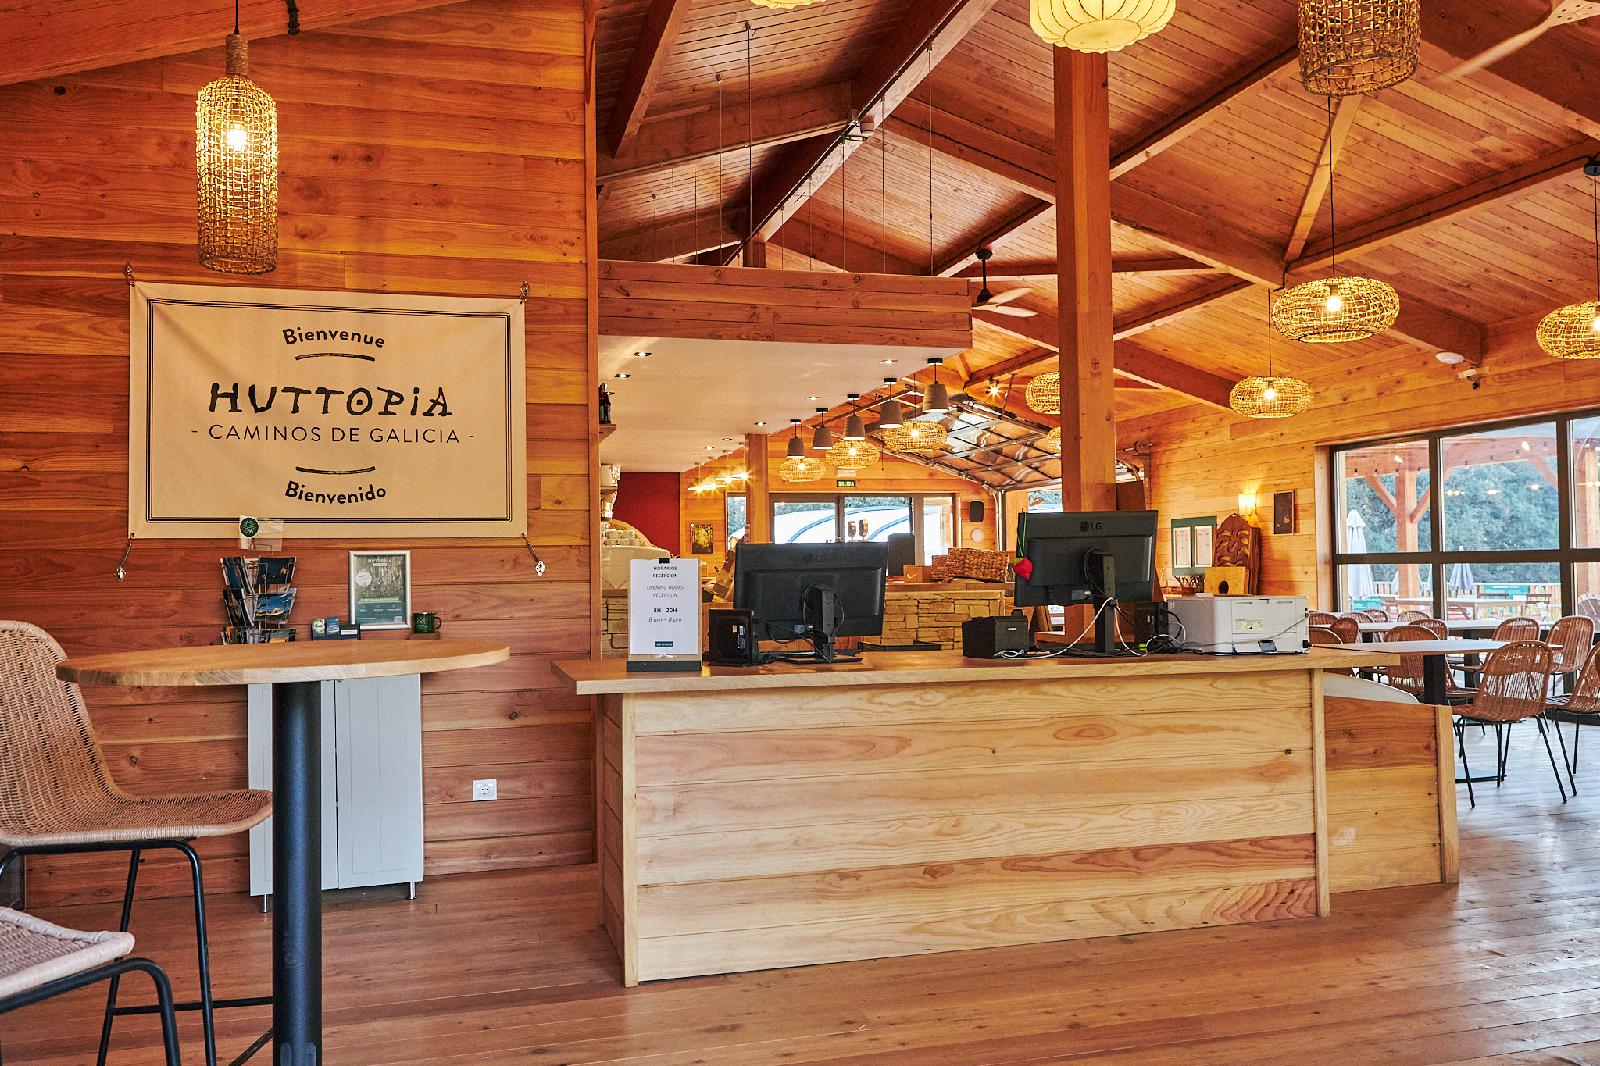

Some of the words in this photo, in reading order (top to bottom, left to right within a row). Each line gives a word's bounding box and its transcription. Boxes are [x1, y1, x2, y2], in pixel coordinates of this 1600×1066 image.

[283, 326, 385, 349] Bienvenue
[208, 424, 321, 442] CAMINOS
[331, 427, 360, 443] DE
[369, 427, 460, 444] GALICIA
[284, 480, 387, 505] Bienvenido
